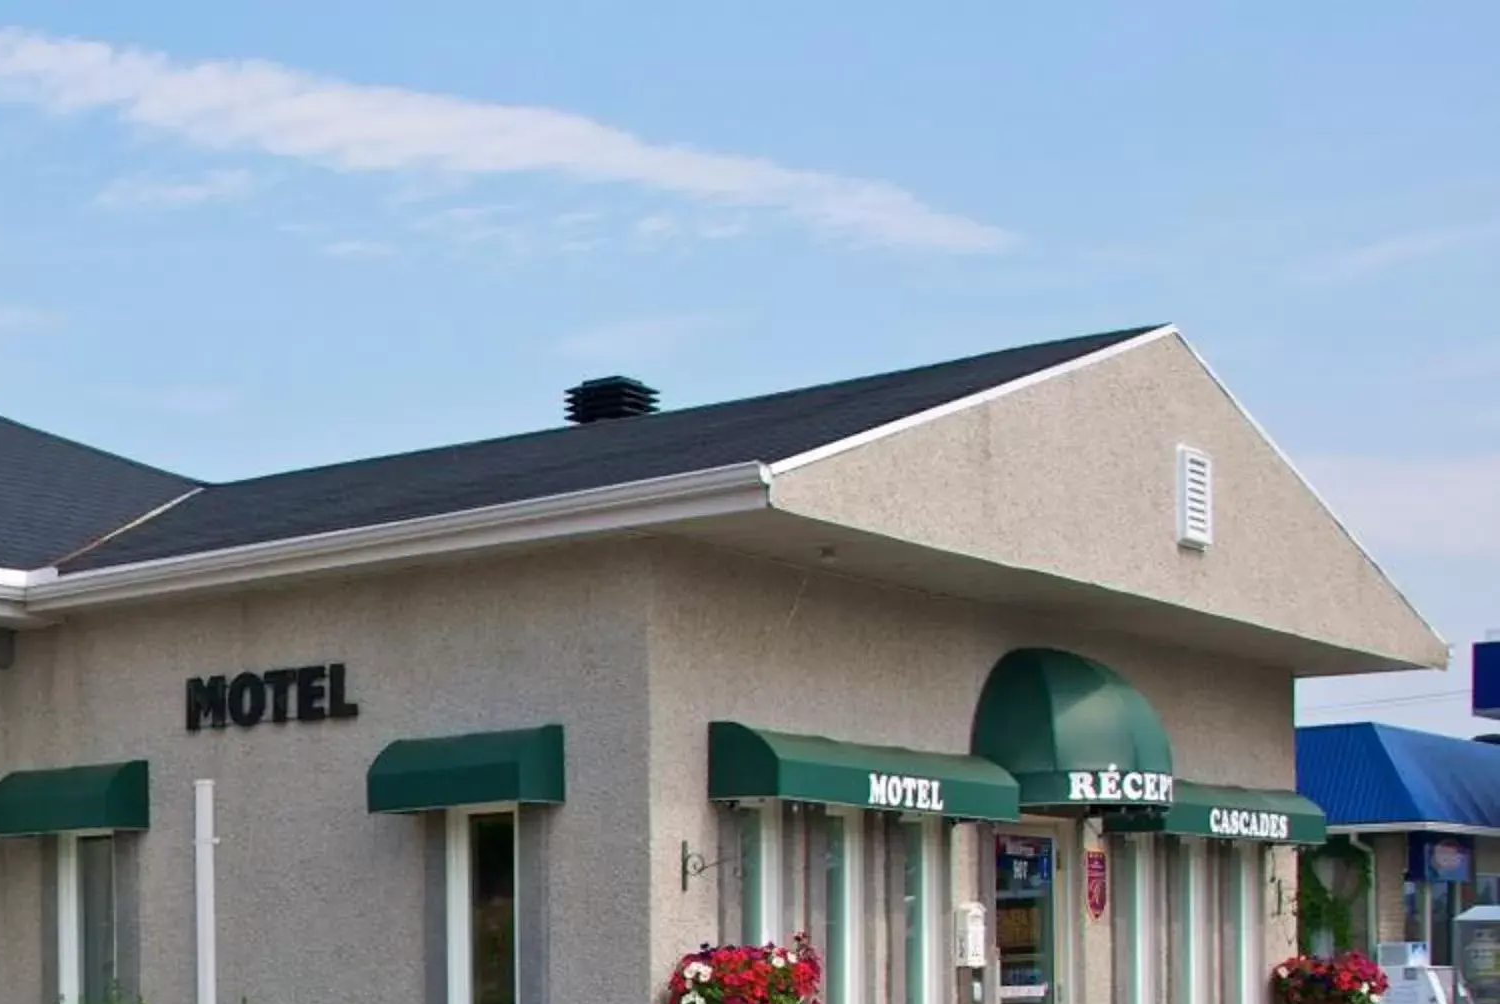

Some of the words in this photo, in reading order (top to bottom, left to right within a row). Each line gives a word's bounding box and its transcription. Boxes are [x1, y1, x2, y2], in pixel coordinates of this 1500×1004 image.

[186, 662, 359, 731] MOTEL
[868, 773, 944, 811] MOTEL
[1208, 807, 1289, 839] CASCADES
